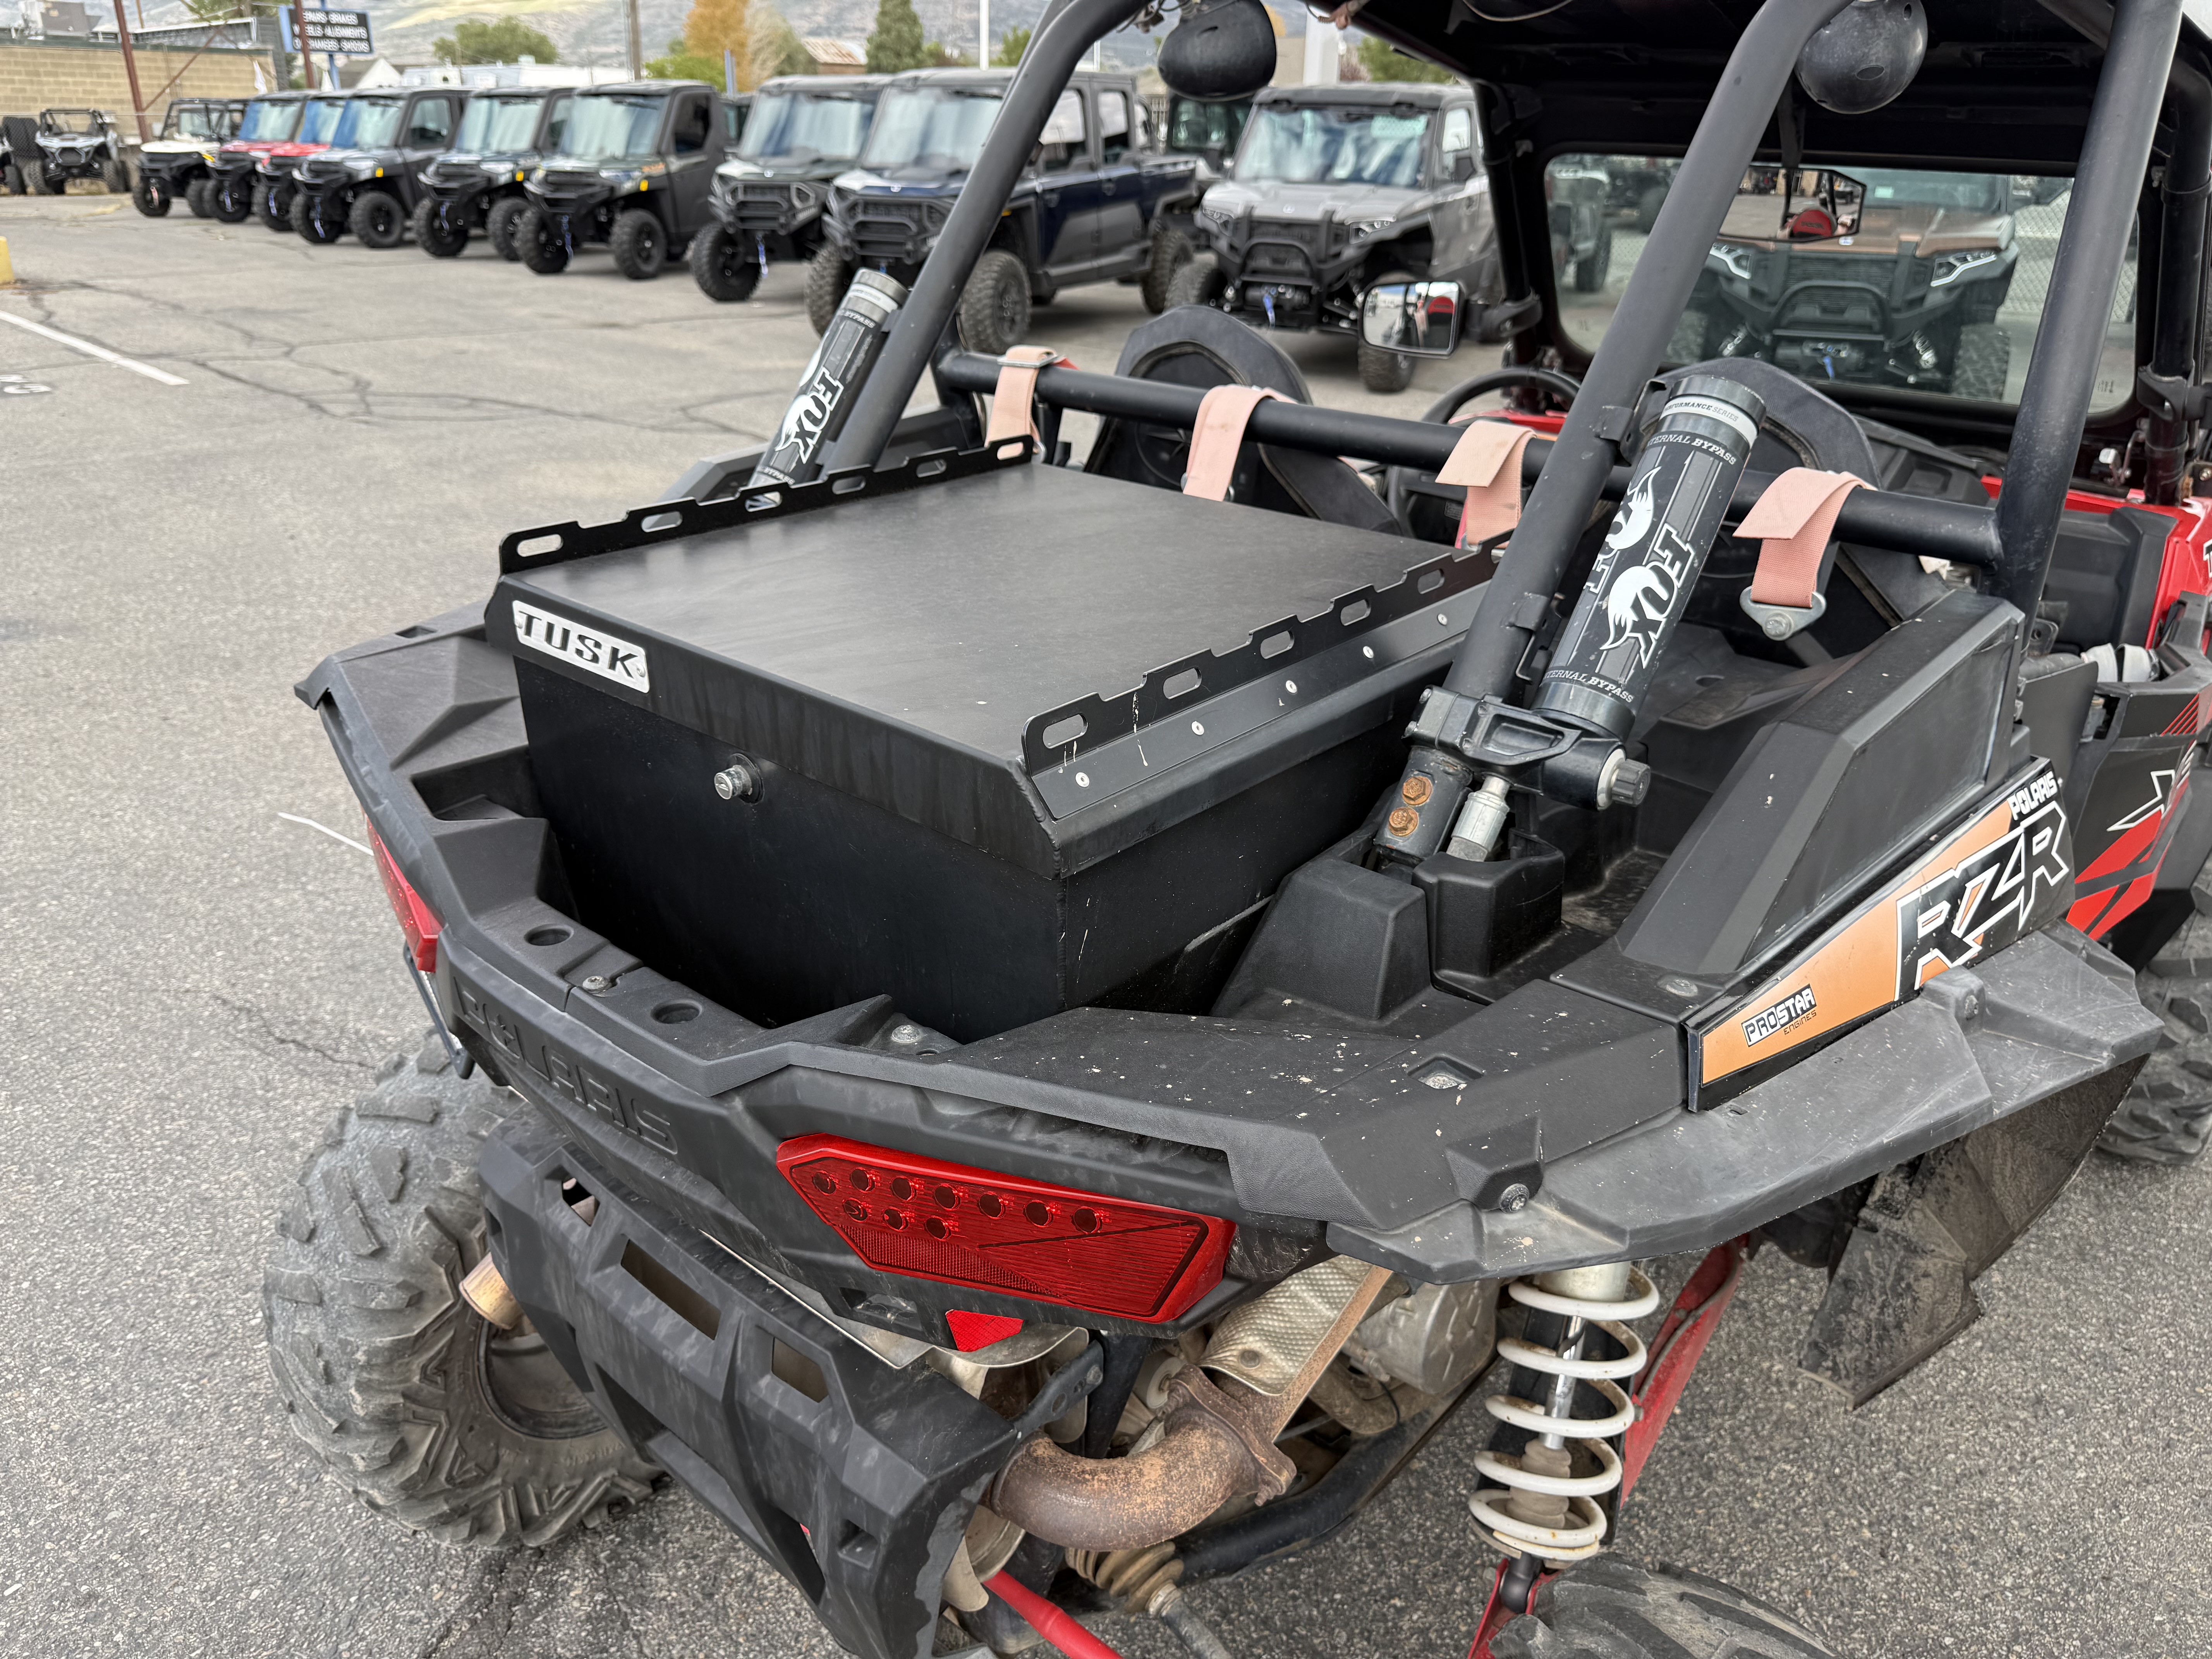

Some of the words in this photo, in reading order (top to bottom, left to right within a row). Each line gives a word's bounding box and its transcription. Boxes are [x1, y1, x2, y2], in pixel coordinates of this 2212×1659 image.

[776, 367, 844, 464] FOX
[1712, 407, 1739, 422] SERIES
[1647, 434, 1691, 447] TERNAL
[1691, 438, 1736, 465] BYPASS
[1599, 523, 1695, 669] FOX
[518, 610, 639, 680] TUSK
[1543, 670, 1588, 682] TERNAL
[1587, 676, 1634, 703] BYPASS
[2006, 770, 2058, 821] POLARIS
[1894, 800, 2069, 1001] RZR
[1744, 988, 1815, 1042] PROSTAR
[1783, 1010, 1817, 1035] ENGINES
[453, 976, 678, 1155] POLARIS
